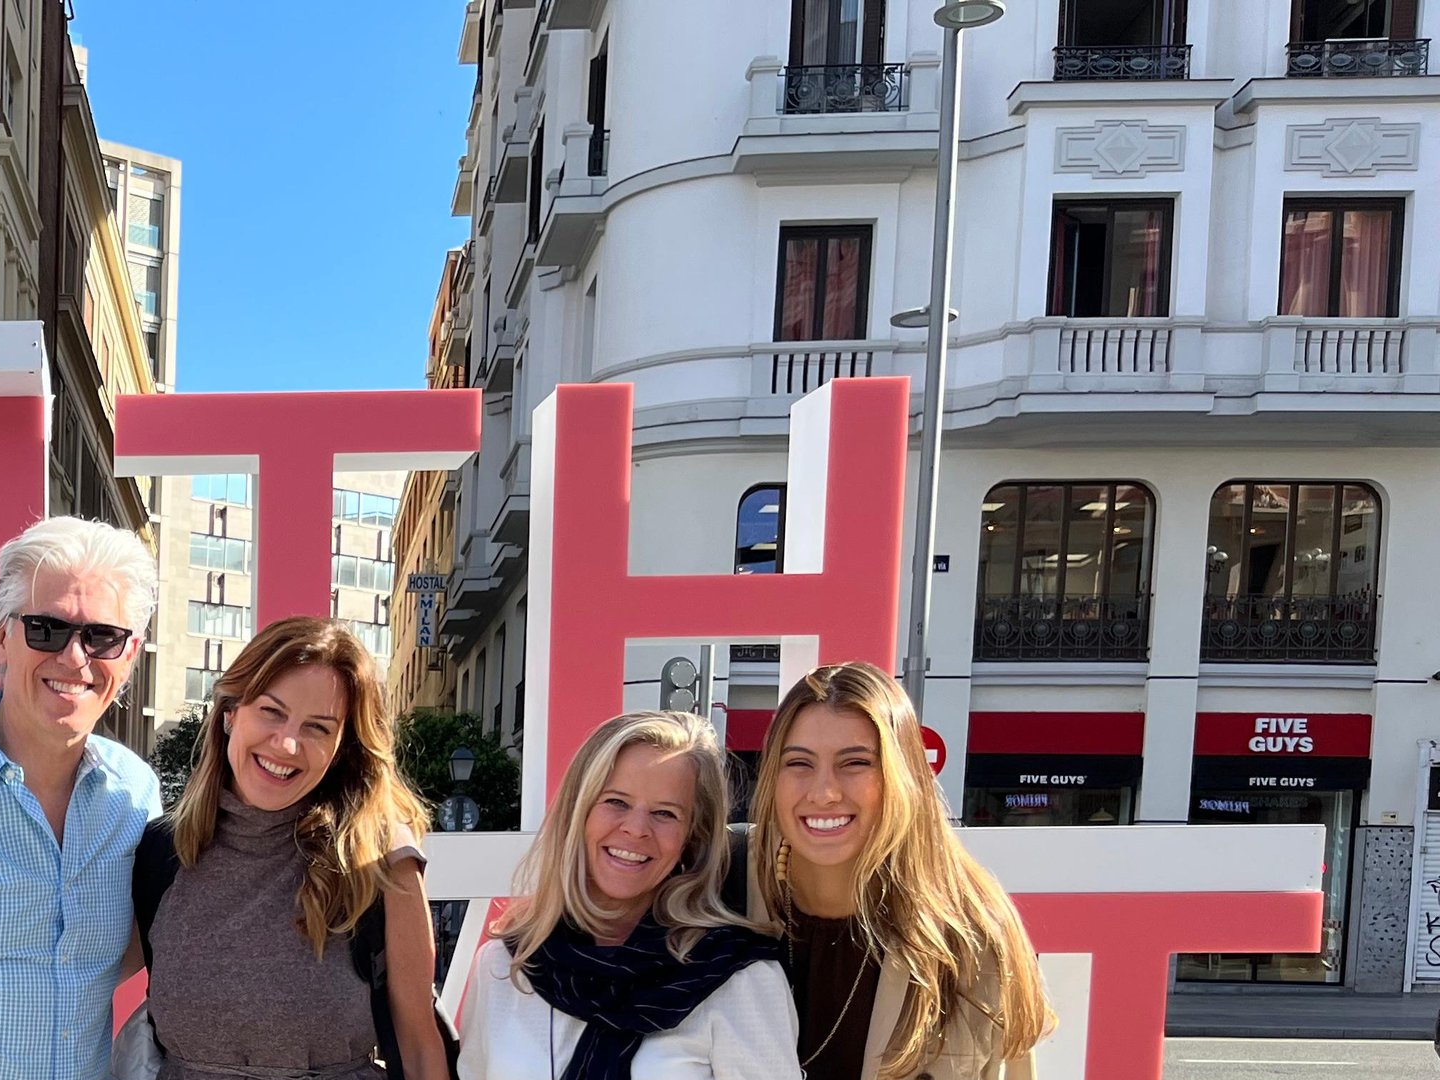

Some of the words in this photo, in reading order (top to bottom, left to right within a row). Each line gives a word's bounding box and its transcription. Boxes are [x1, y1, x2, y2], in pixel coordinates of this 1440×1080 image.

[409, 576, 445, 589] HOSTAL
[419, 600, 433, 645] MILAN
[1254, 717, 1308, 734] FIVE
[1248, 736, 1314, 753] GUYS
[1019, 774, 1048, 784] FIVE
[1050, 774, 1086, 785] GUYS
[1248, 777, 1277, 787] FIVE
[1280, 777, 1315, 787] GUYS
